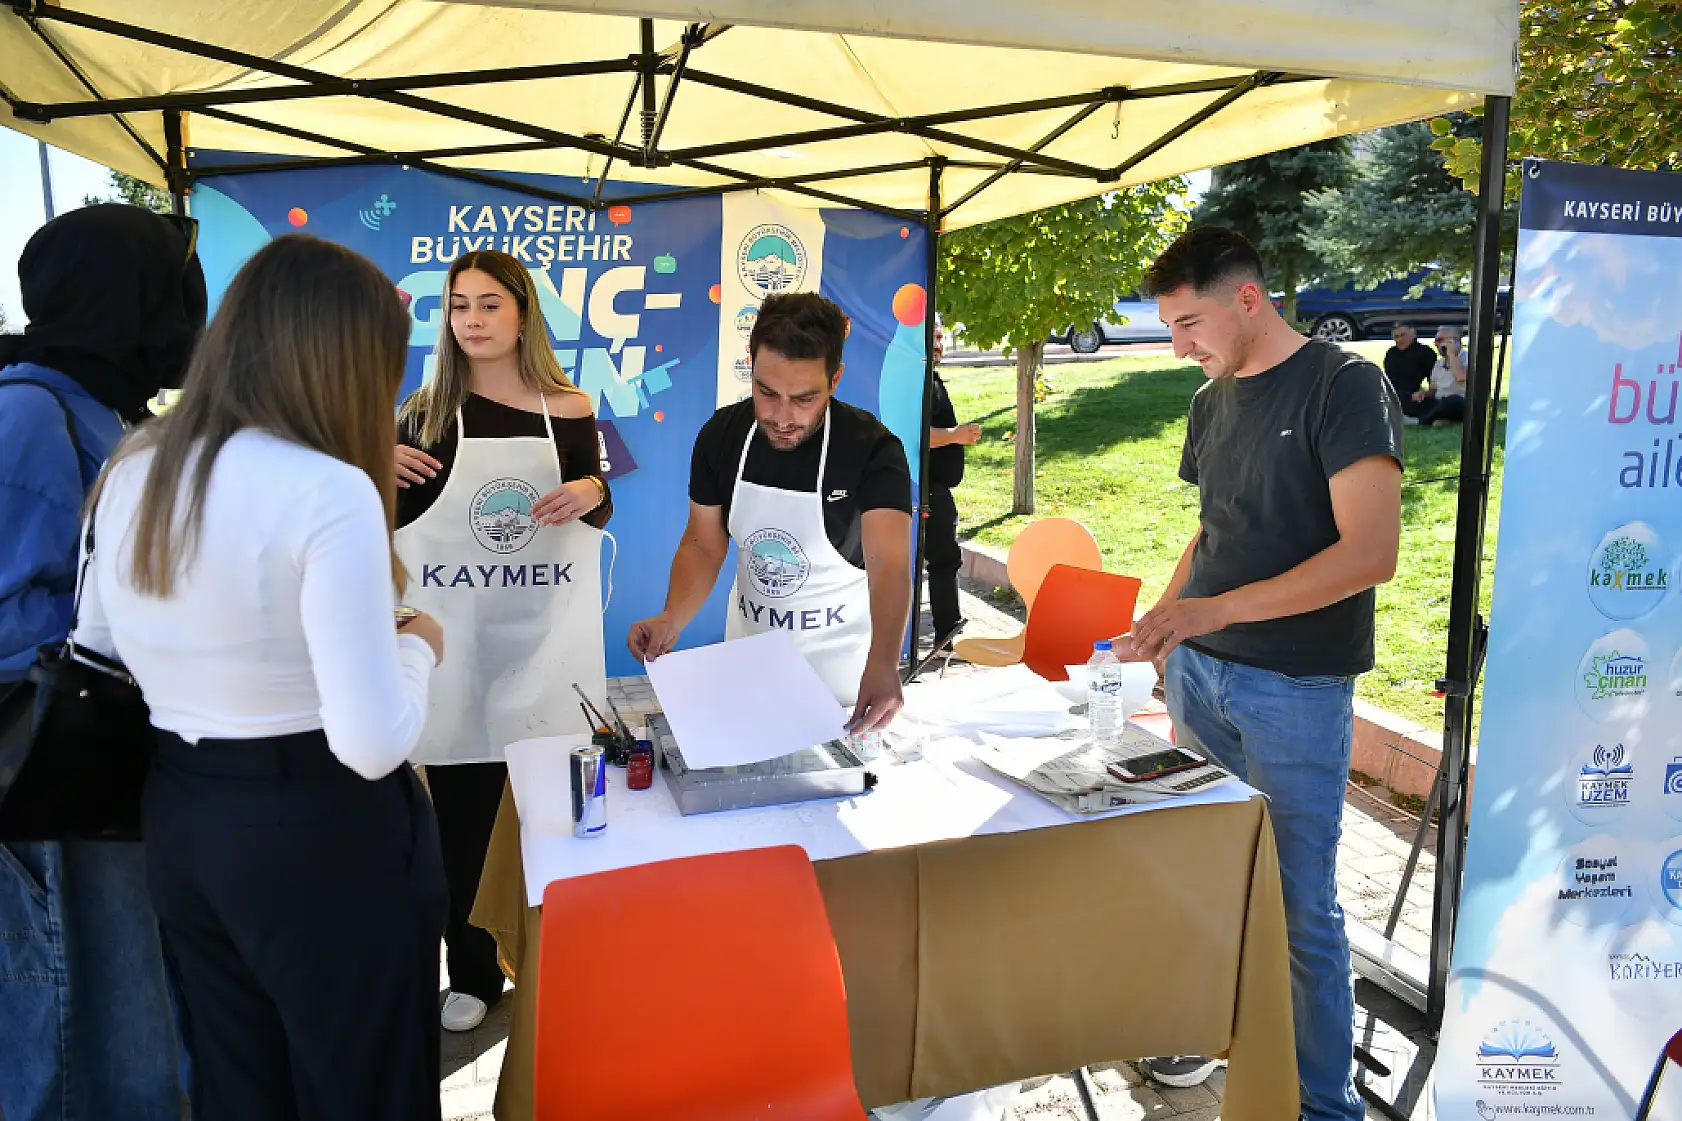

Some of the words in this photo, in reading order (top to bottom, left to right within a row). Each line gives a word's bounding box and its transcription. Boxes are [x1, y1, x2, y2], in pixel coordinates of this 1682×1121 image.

[1564, 201, 1640, 221] KAYSERİ
[421, 562, 574, 588] KAYMEK
[738, 595, 846, 632] AYMEK
[1605, 663, 1643, 676] huzur
[1581, 781, 1628, 791] KAYMEK
[1558, 885, 1633, 900] Merkezleri
[1481, 1067, 1556, 1080] KAYMEK
